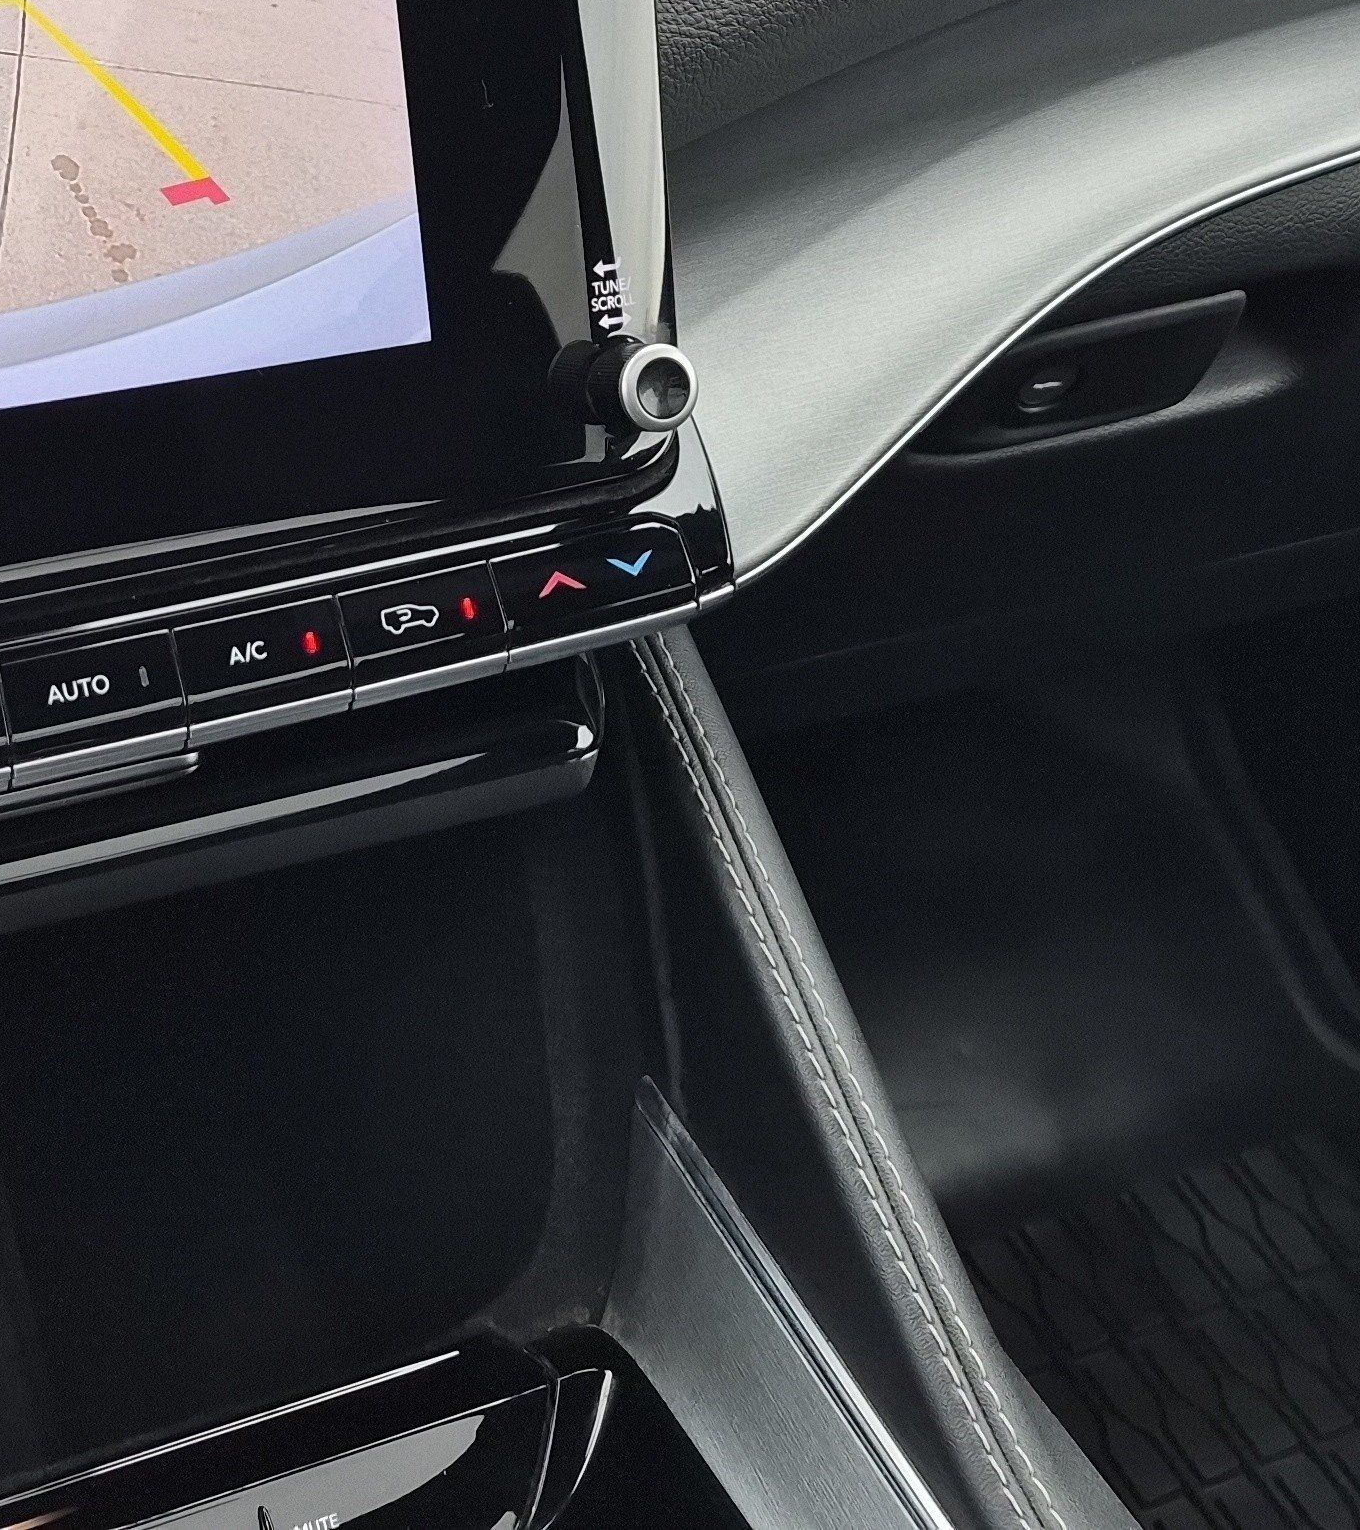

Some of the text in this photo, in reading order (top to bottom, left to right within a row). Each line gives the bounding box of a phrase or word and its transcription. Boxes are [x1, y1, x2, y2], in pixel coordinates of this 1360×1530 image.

[591, 276, 632, 295] TUNE/
[590, 294, 637, 312] SCROLL
[229, 640, 268, 666] A/C
[47, 674, 110, 706] AUTO
